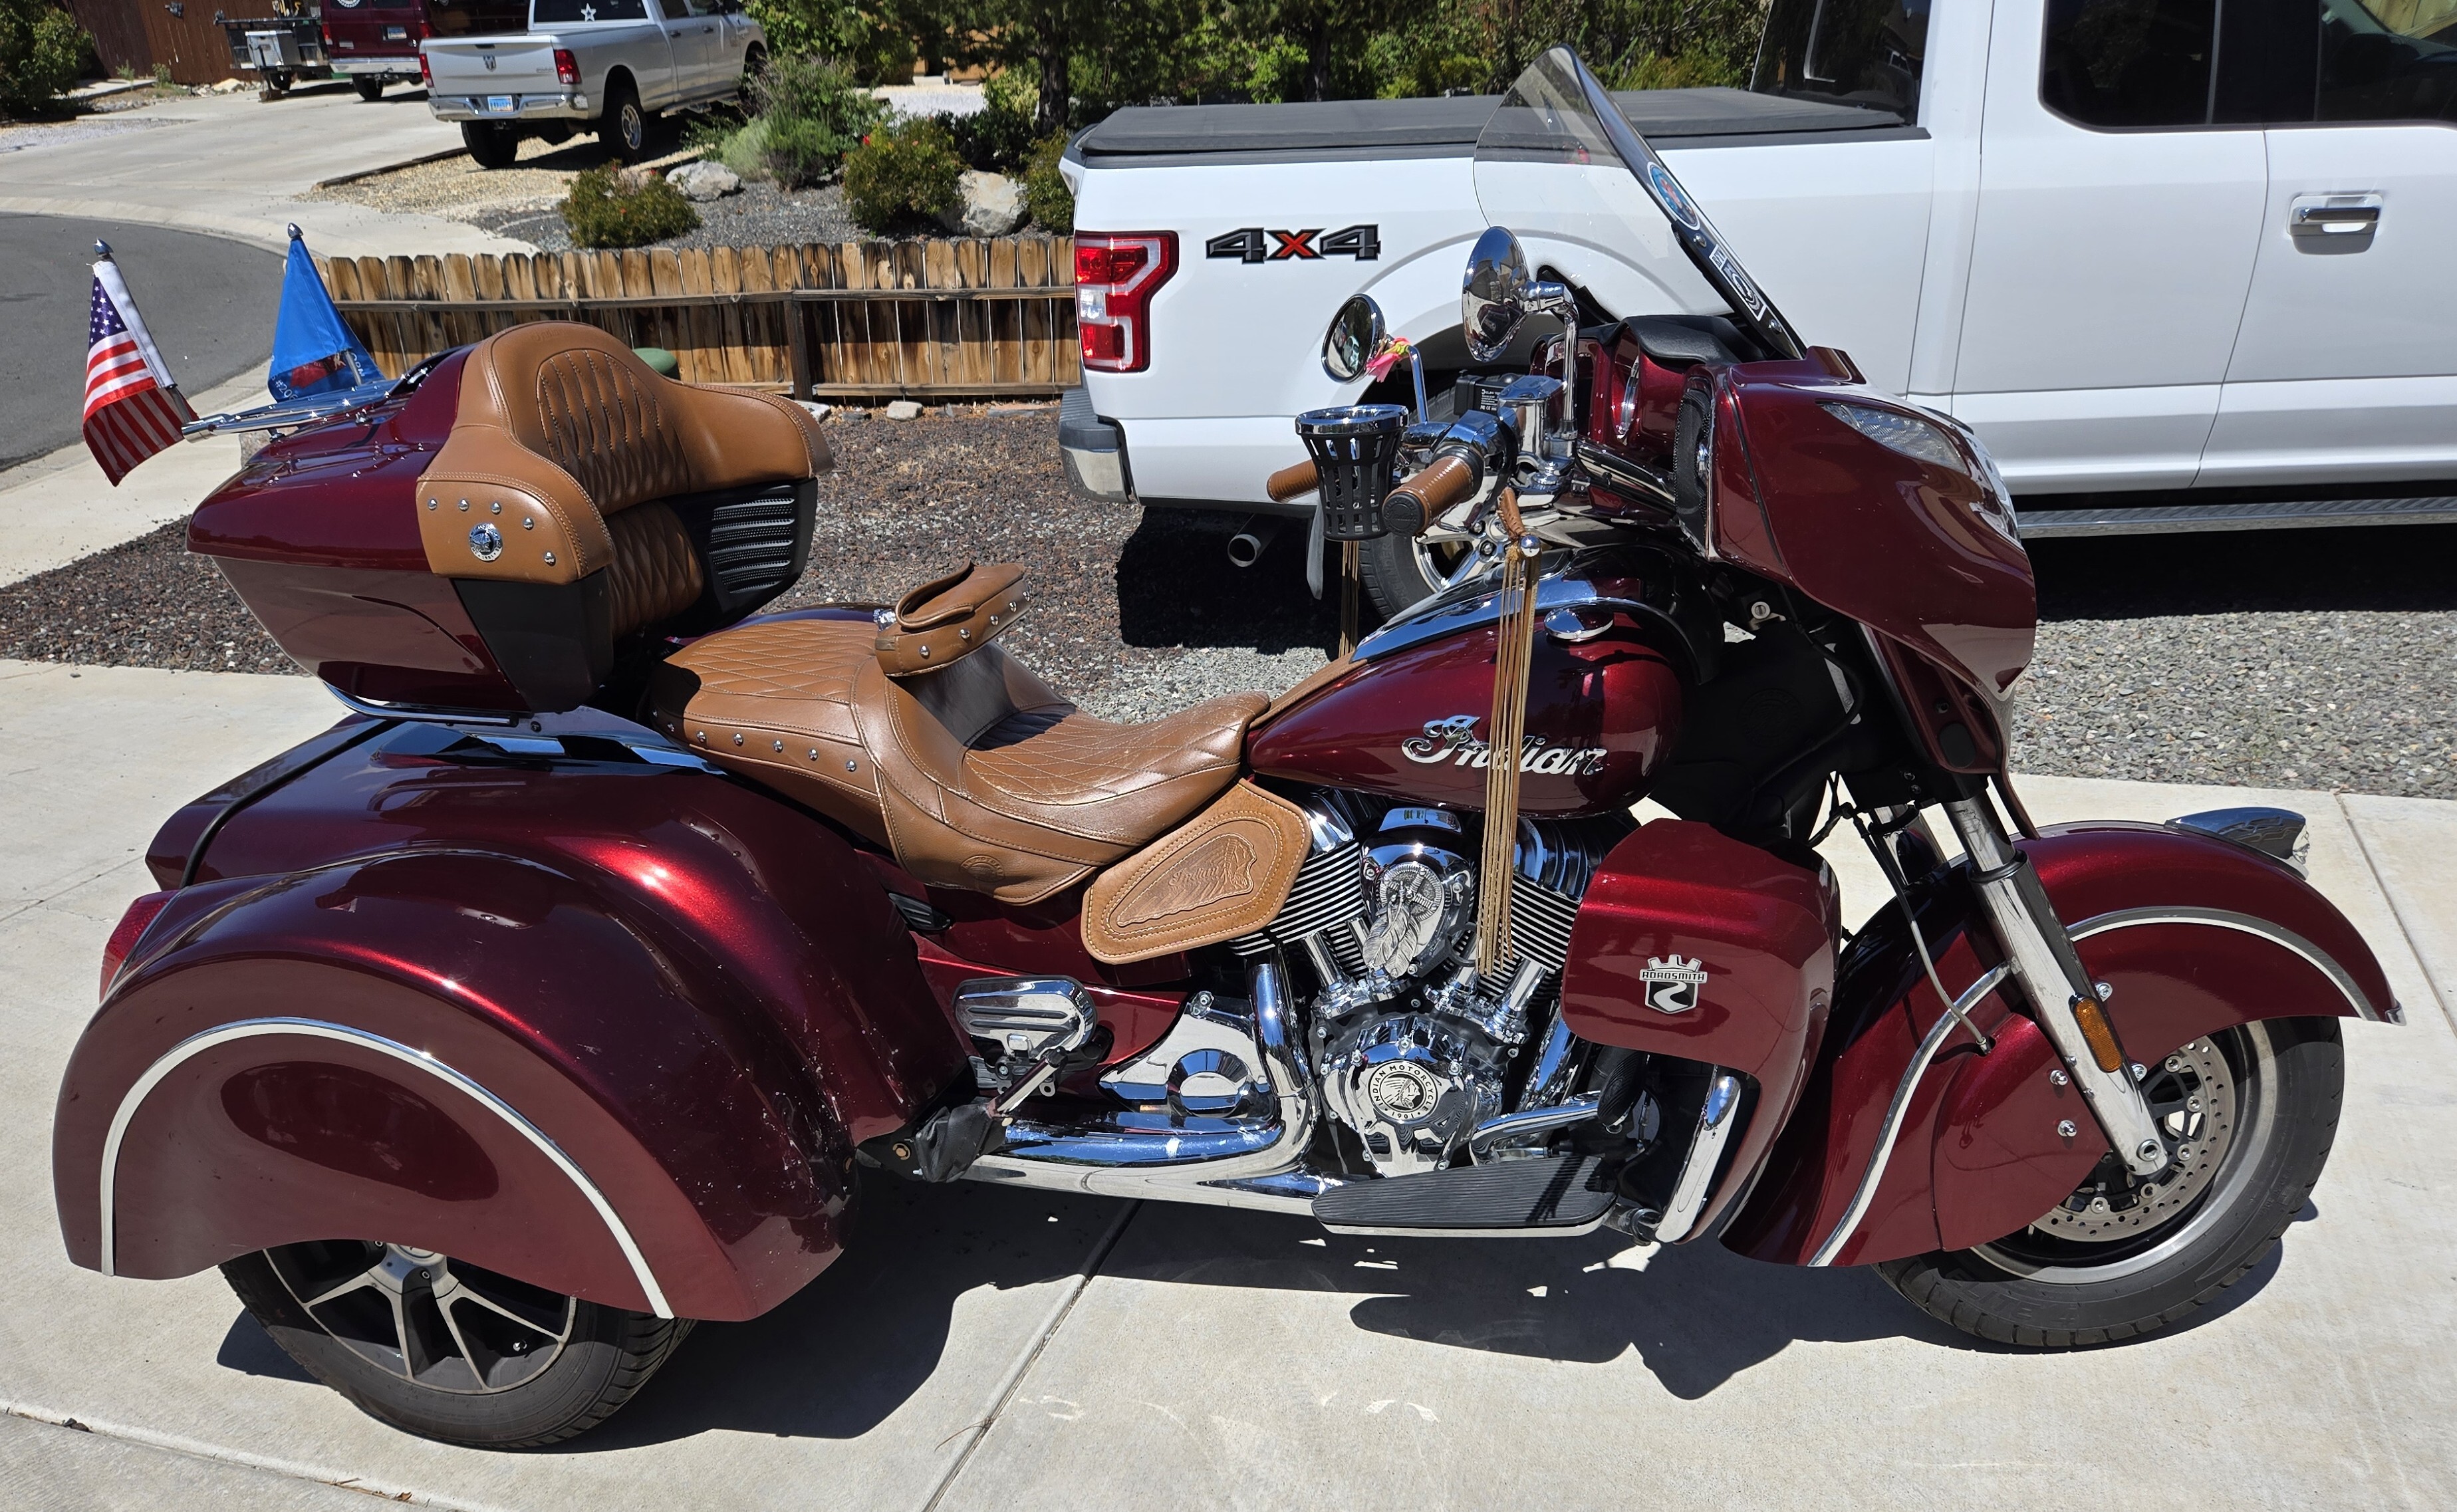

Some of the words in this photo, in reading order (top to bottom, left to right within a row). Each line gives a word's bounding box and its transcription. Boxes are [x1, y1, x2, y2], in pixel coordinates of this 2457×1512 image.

[1206, 224, 1381, 264] 4x4
[1168, 866, 1219, 886] Indian
[1642, 971, 1705, 981] ROADSMITH
[1372, 1071, 1386, 1106] INDIAN
[1389, 1065, 1434, 1111] MOTORCYCLE
